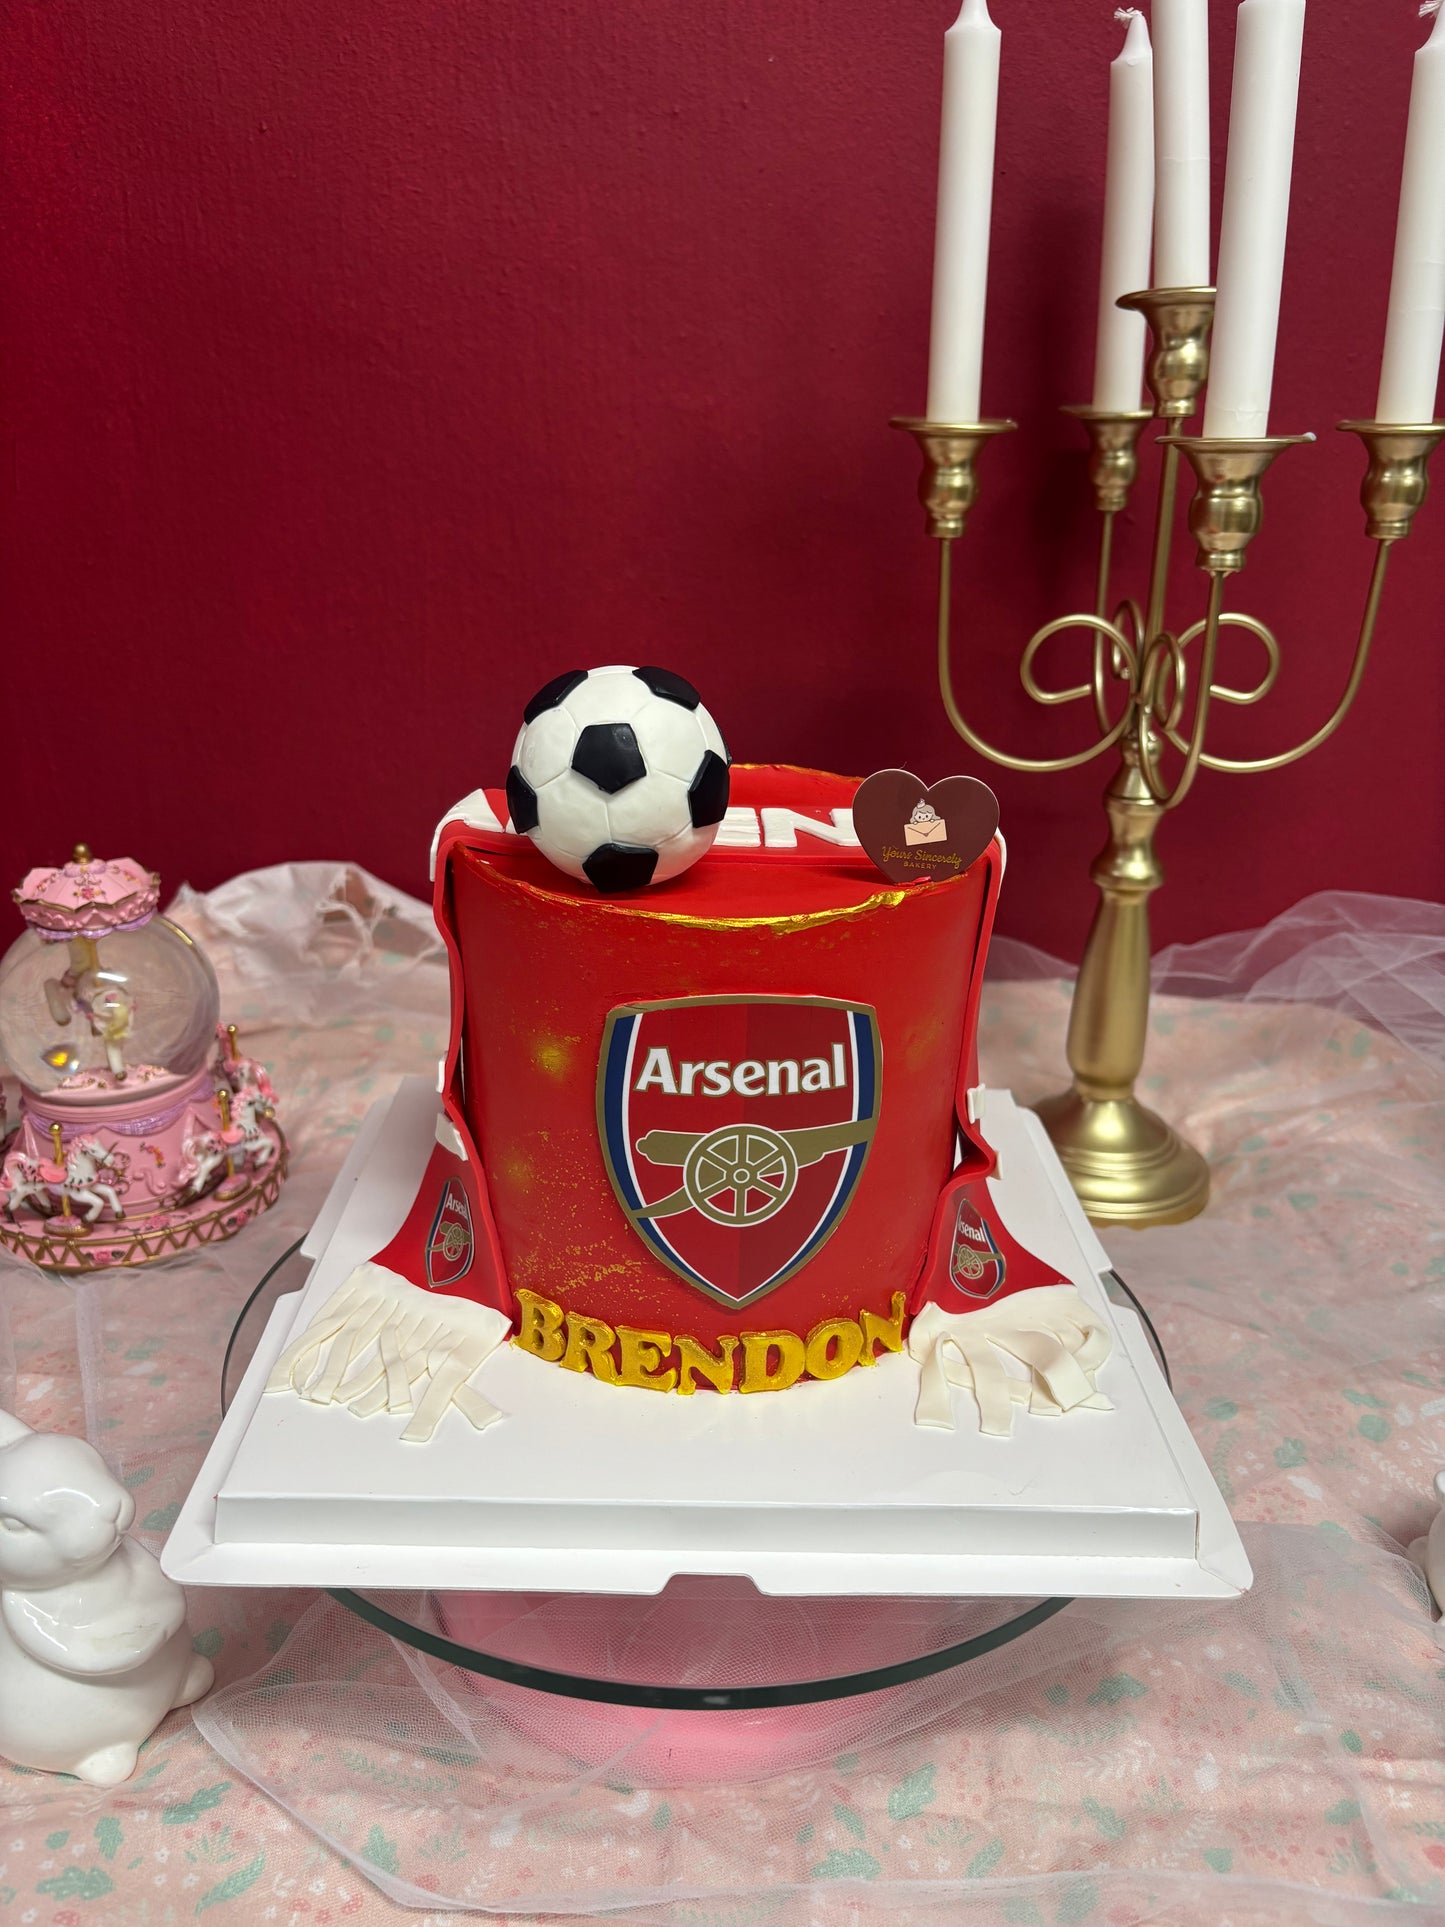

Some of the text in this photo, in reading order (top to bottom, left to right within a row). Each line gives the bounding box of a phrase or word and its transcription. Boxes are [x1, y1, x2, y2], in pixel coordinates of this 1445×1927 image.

[882, 846, 962, 870] Yours Sincerely
[903, 860, 937, 870] BAKERY
[634, 1042, 847, 1096] Arsenal
[511, 1288, 908, 1396] BRENDON
